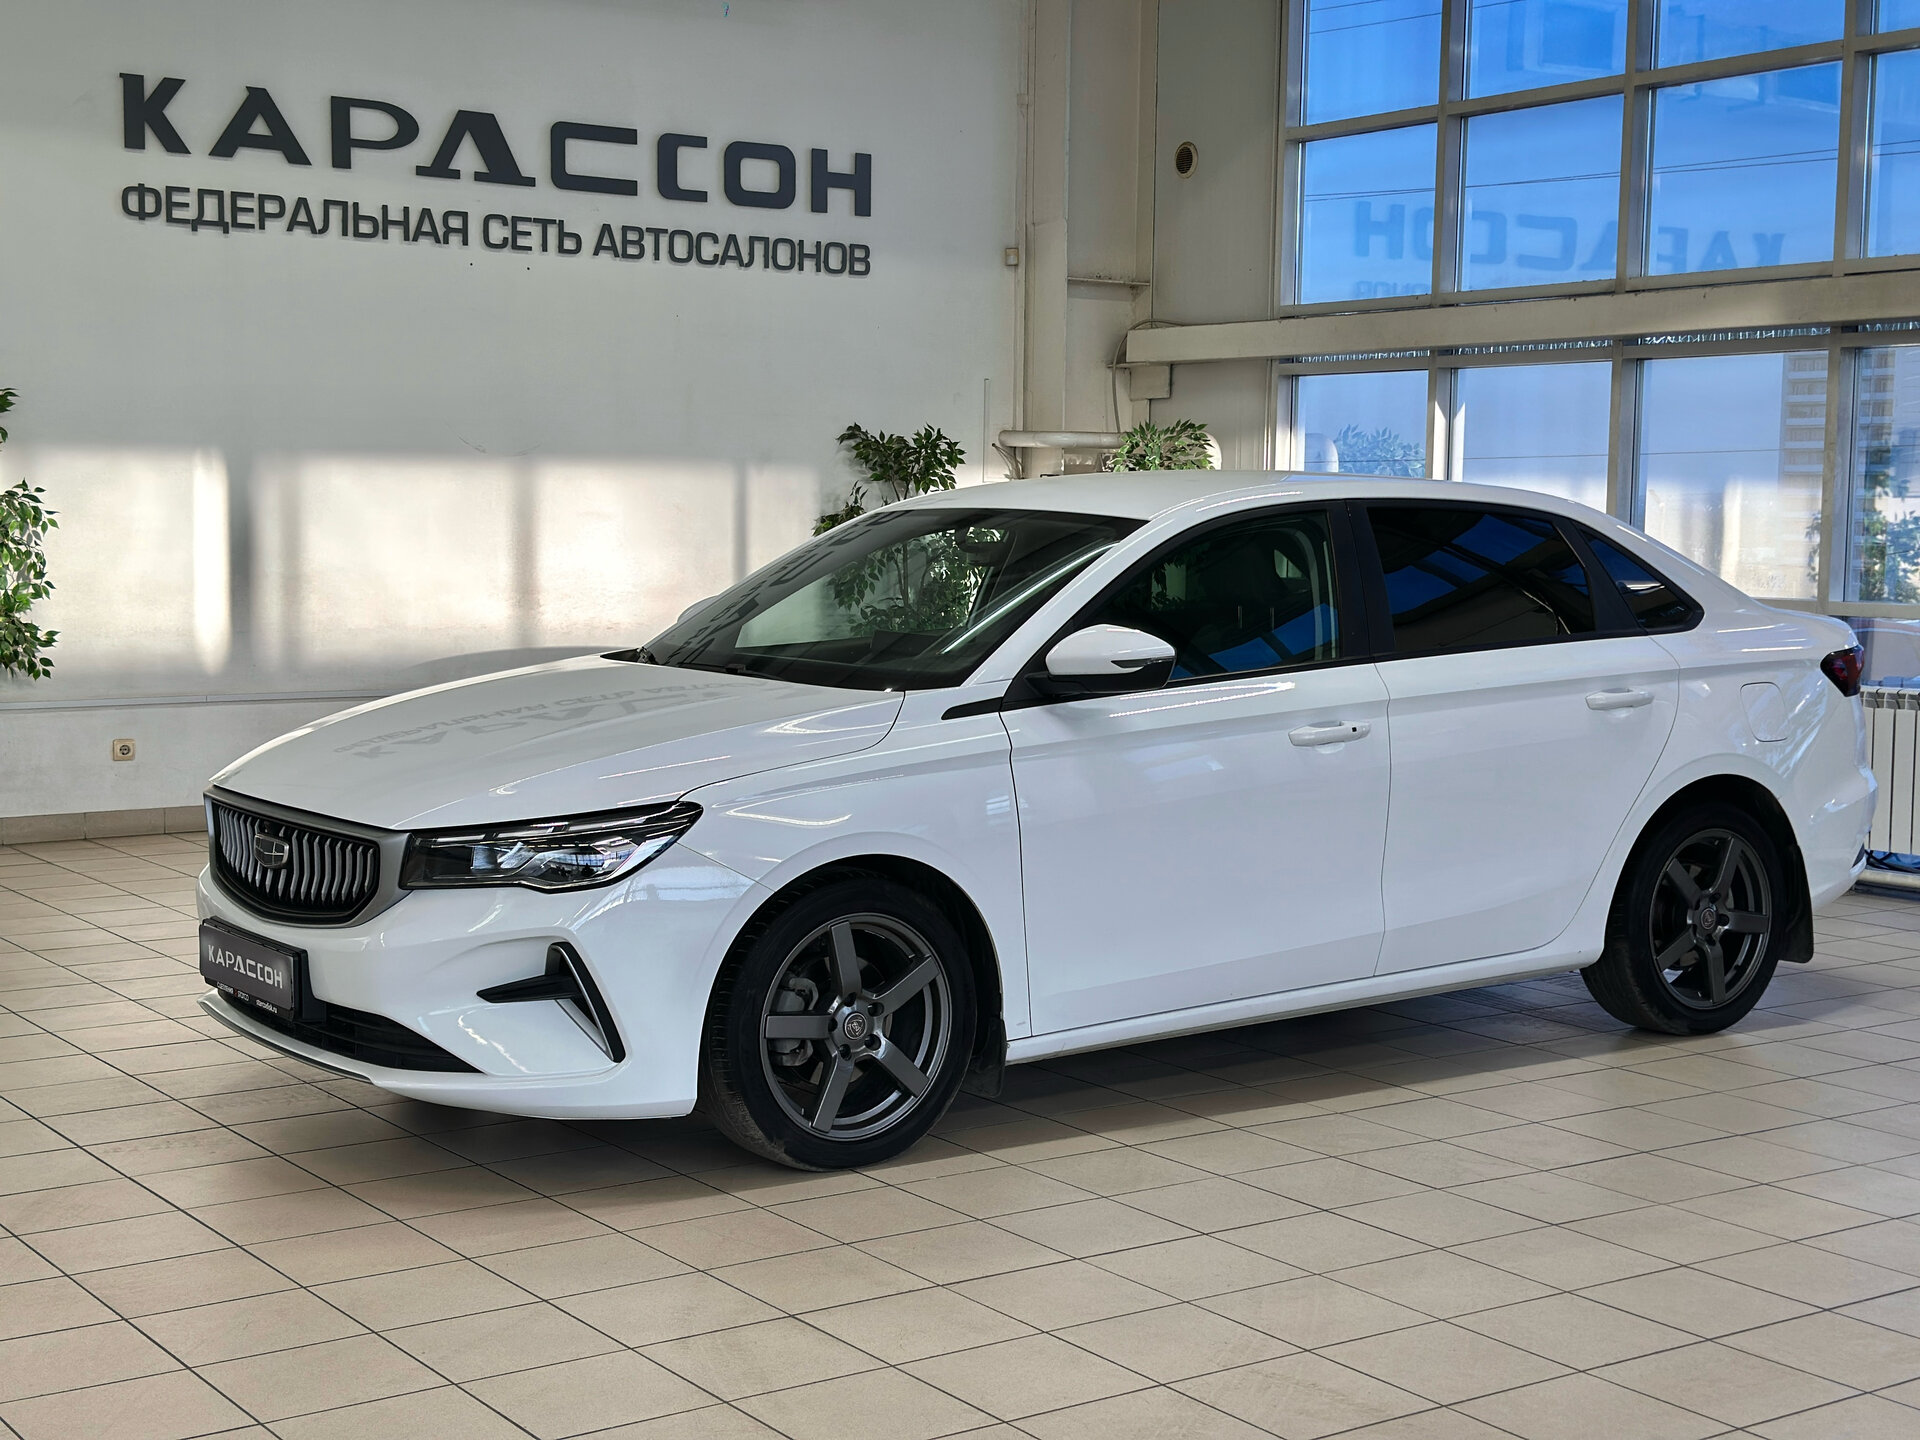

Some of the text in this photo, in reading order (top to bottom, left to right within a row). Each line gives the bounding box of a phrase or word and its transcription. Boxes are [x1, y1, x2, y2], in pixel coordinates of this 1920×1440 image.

[119, 72, 872, 217] КАРАССОН
[121, 183, 871, 276] ФЕДЕРАЛЬНАЯ СЕТЬ АВТОСАЛОНОВ
[208, 944, 283, 989] КАРАССОН
